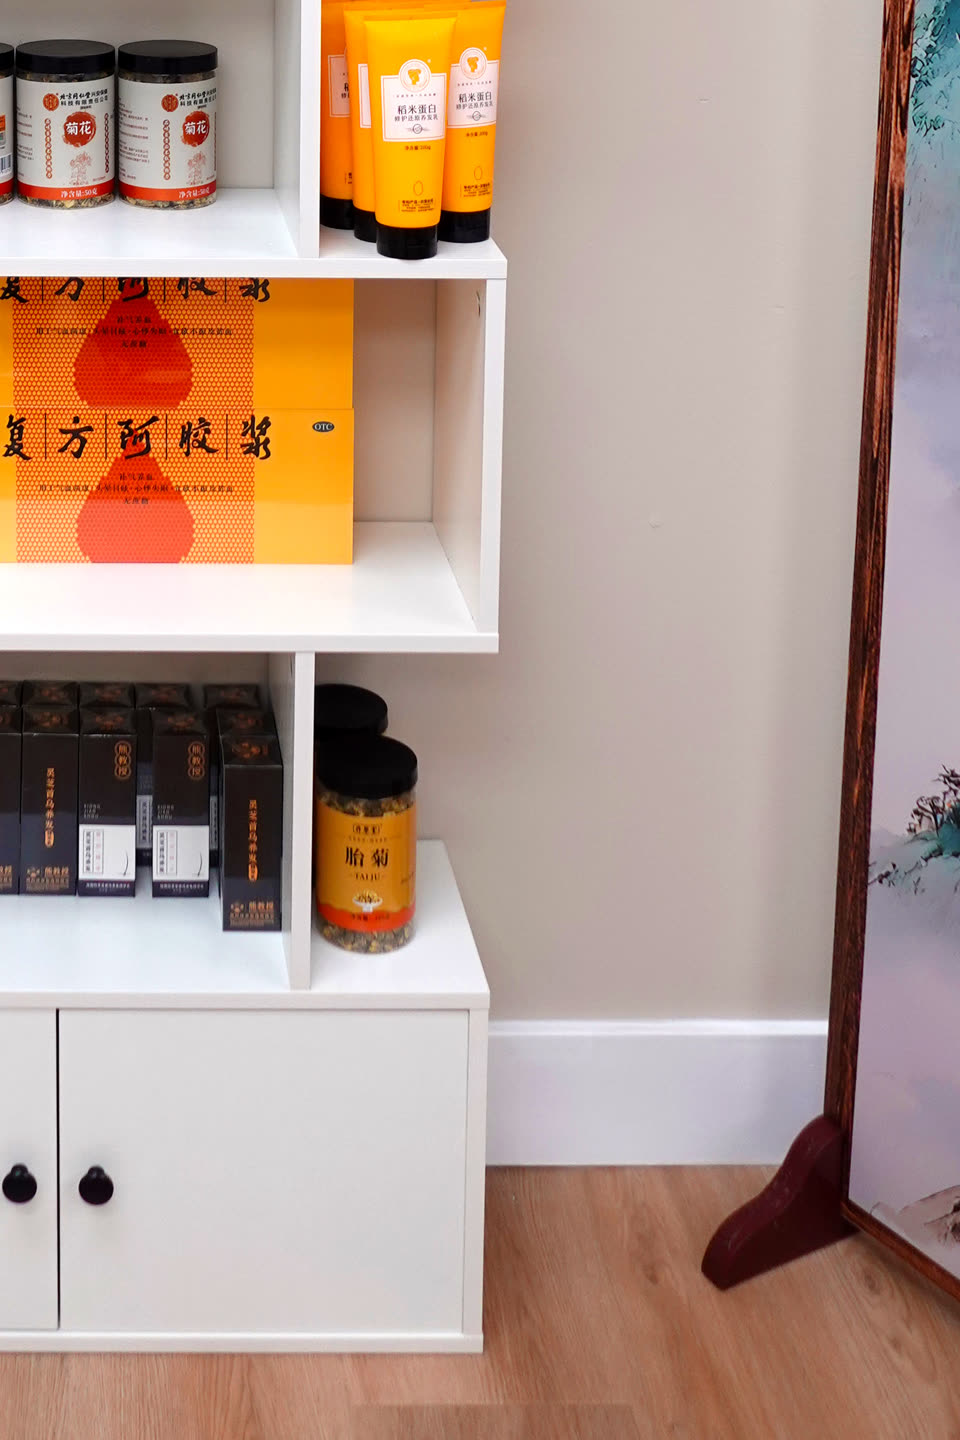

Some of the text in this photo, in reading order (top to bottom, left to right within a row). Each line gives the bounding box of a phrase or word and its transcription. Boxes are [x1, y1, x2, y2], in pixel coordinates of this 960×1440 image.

[459, 91, 492, 103] 稻米蛋白
[397, 104, 437, 115] 稻米蛋白
[66, 121, 91, 136] 菊花
[185, 120, 207, 135] 菊花
[313, 422, 333, 431] OTC
[2, 414, 272, 461] 复方阿胶浆
[345, 846, 389, 868] 胎菊
